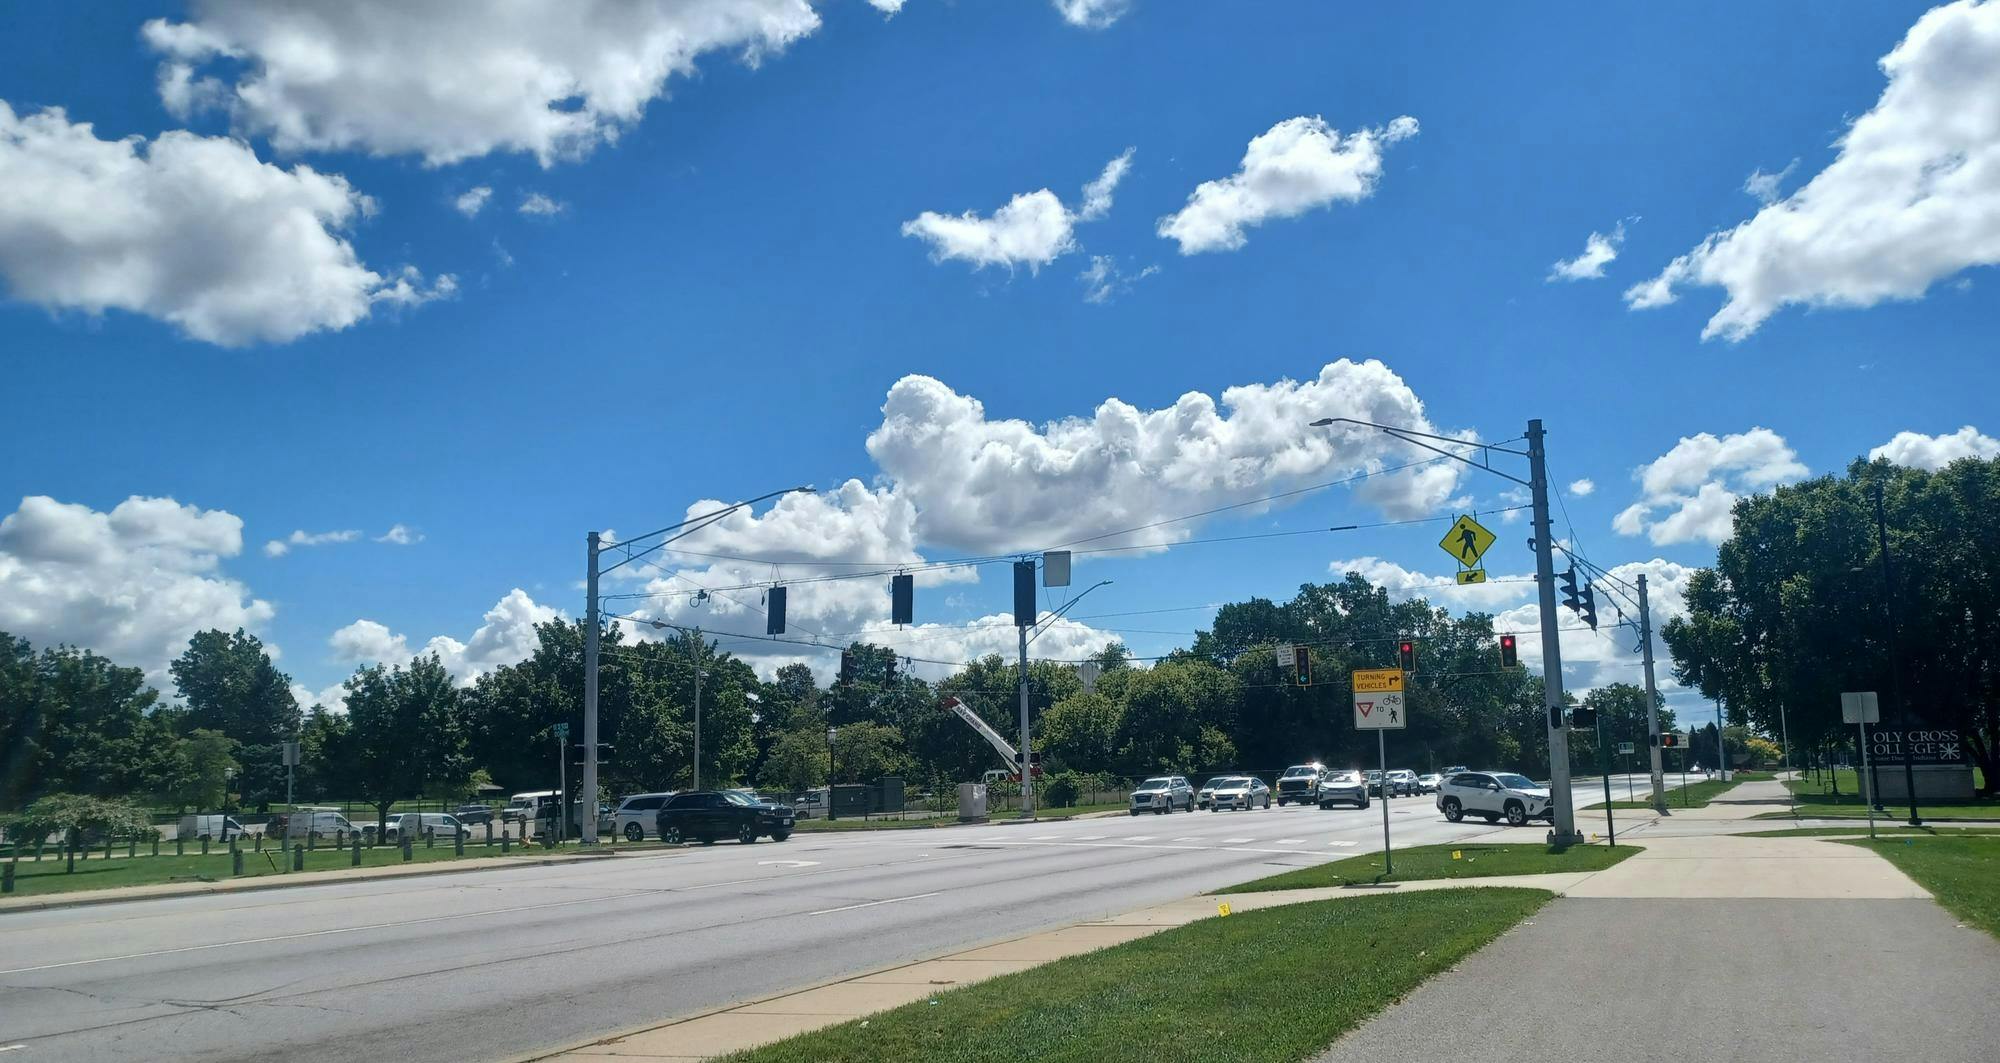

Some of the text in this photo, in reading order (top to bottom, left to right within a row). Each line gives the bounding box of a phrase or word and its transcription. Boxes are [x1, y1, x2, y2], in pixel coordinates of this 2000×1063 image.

[1356, 673, 1386, 681] TURNING
[1873, 730, 1959, 743] OLY CROSS
